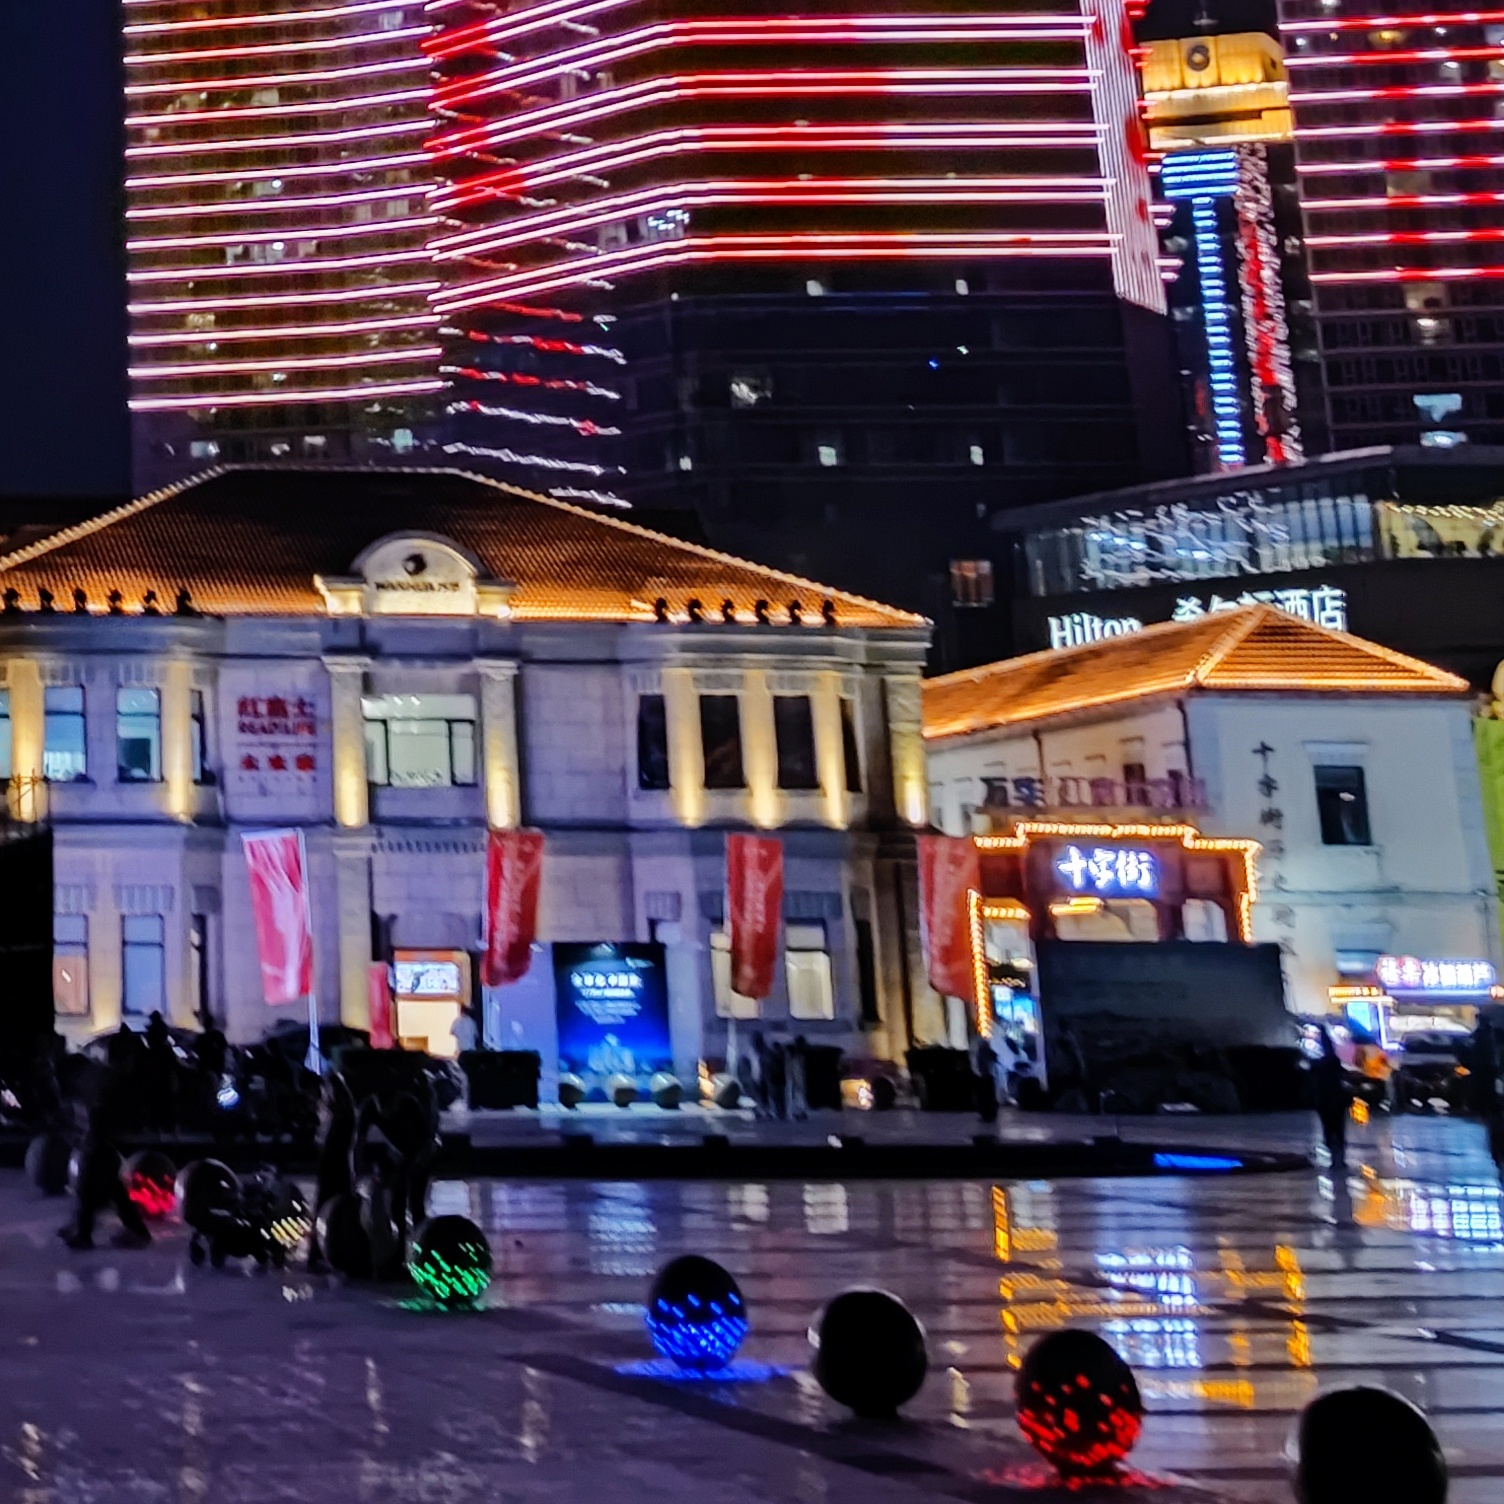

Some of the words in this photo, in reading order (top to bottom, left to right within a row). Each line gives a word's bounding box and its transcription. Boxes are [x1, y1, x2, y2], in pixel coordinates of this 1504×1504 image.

[1048, 610, 1142, 651] Hilton
[1056, 844, 1153, 889] 十字街
